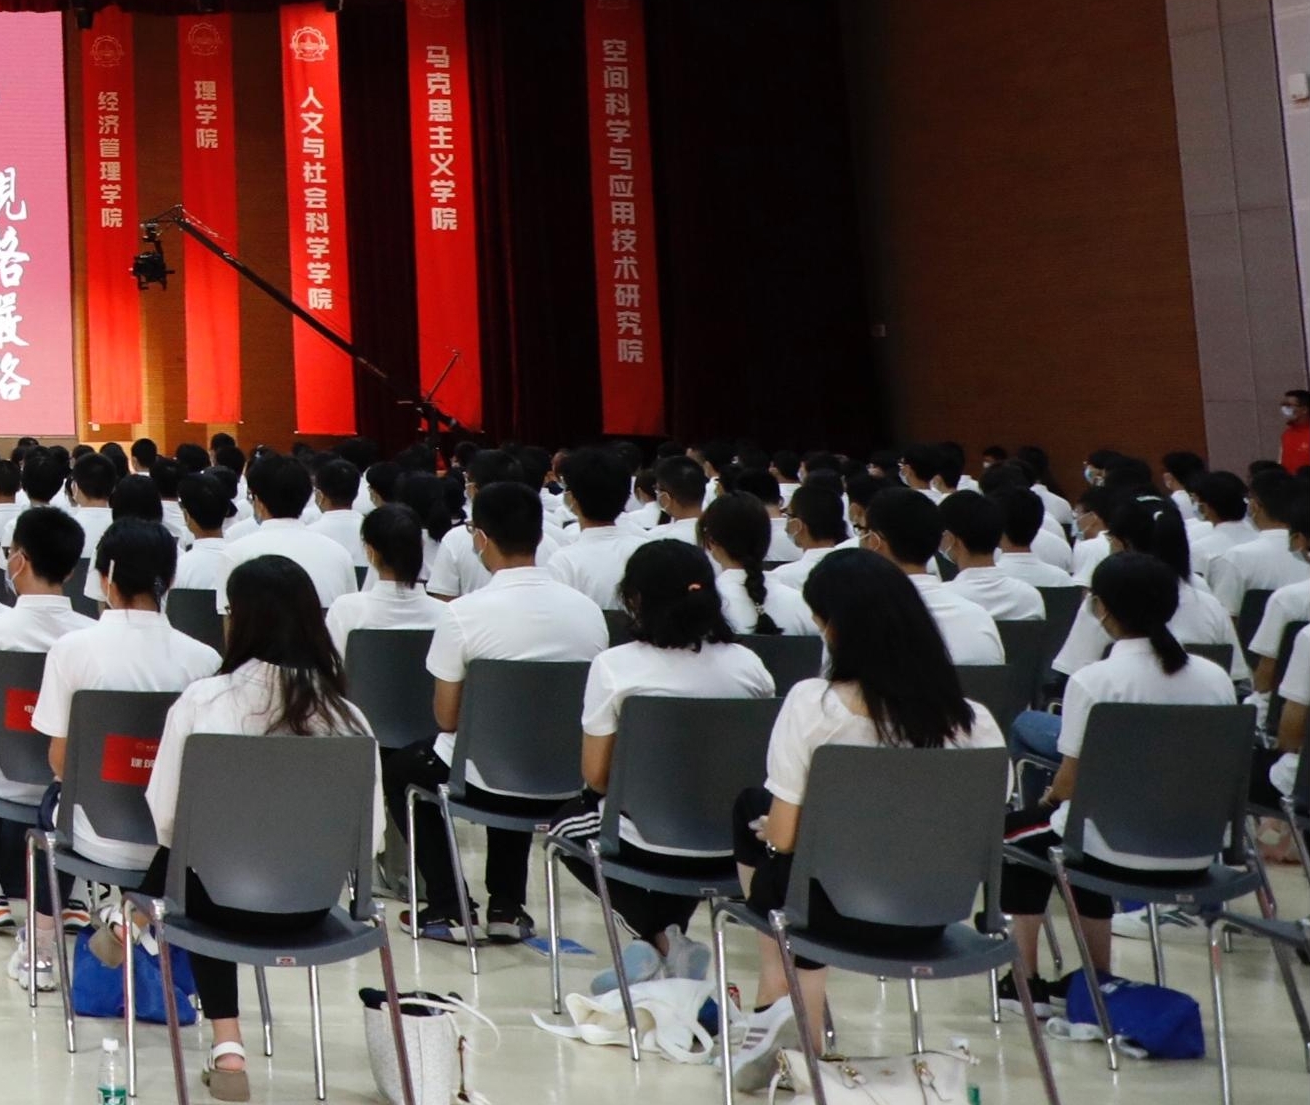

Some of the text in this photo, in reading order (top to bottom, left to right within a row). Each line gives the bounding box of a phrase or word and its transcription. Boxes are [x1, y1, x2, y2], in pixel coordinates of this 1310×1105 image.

[97, 91, 123, 228] 经济管理学院
[194, 80, 219, 149] 理学院
[300, 86, 333, 310] 人文与社会科学学院
[426, 45, 458, 231] 马克思主义学院
[602, 38, 644, 363] 空间科学与应用技术研究院
